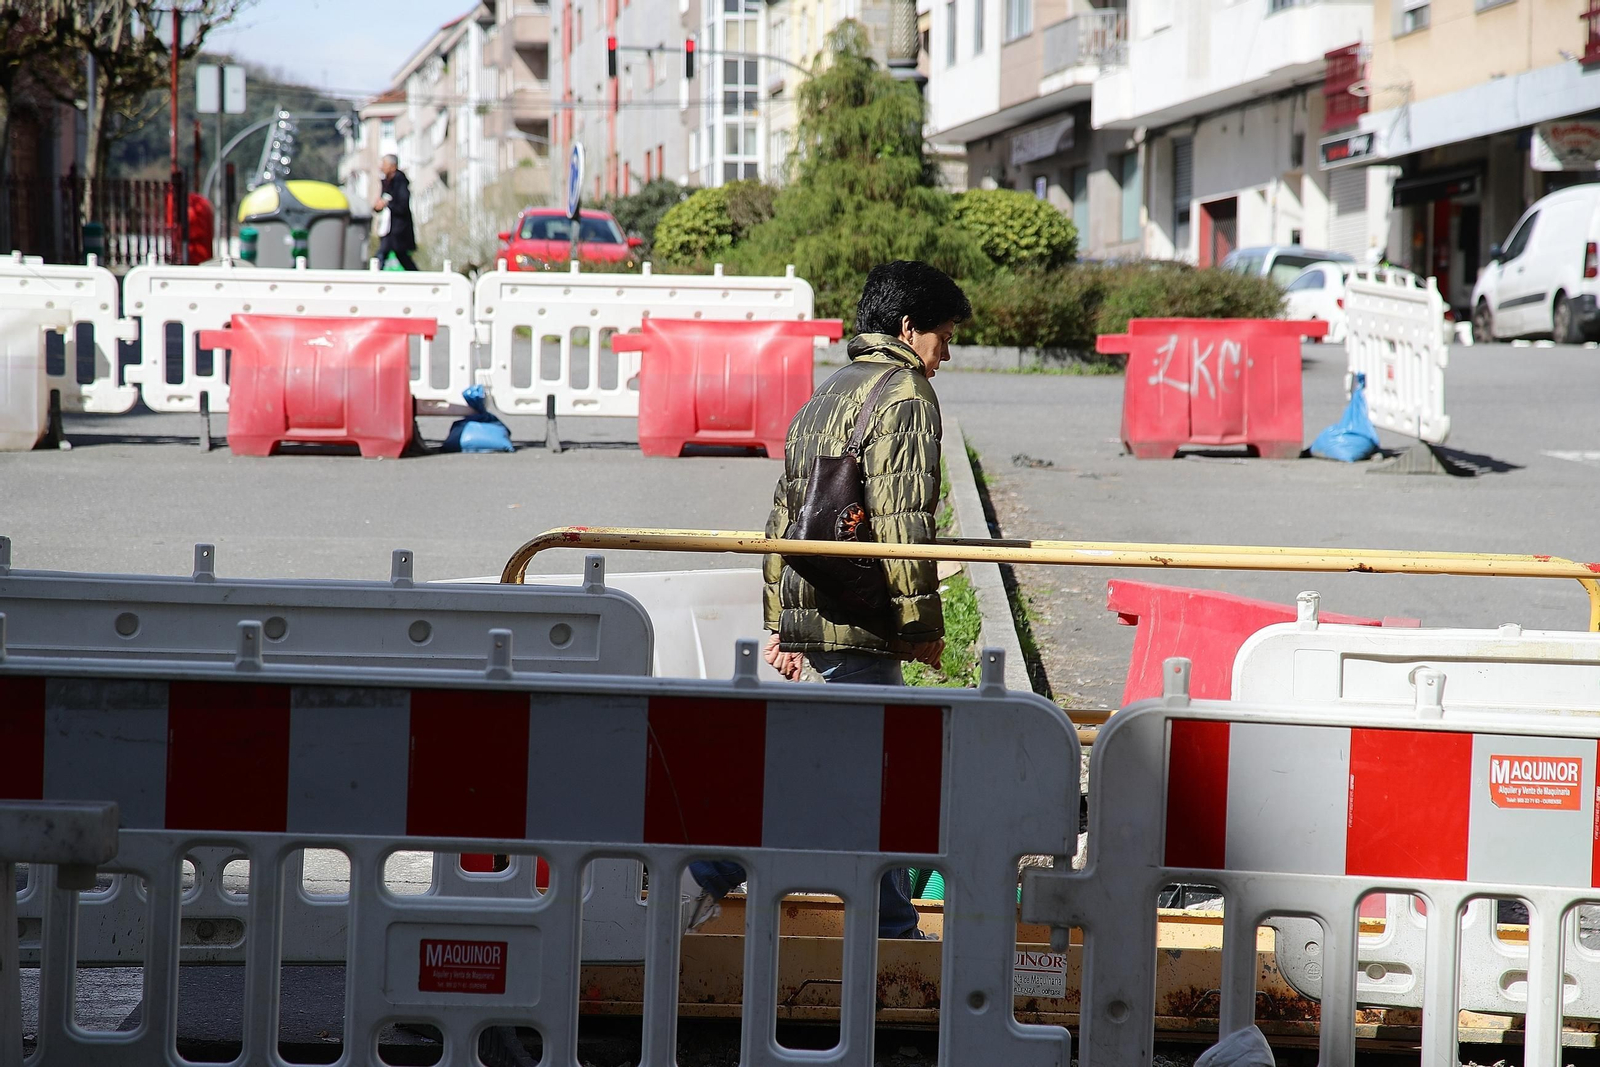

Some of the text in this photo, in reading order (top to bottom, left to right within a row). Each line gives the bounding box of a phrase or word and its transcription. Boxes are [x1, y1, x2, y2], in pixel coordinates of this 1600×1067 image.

[1491, 759, 1578, 784] MAQUINOR
[1499, 786, 1517, 796] Alquiler
[1522, 786, 1536, 795] Venta
[1537, 787, 1543, 795] de
[1544, 787, 1570, 797] Maquinaria
[426, 944, 500, 967] MAQUINOR
